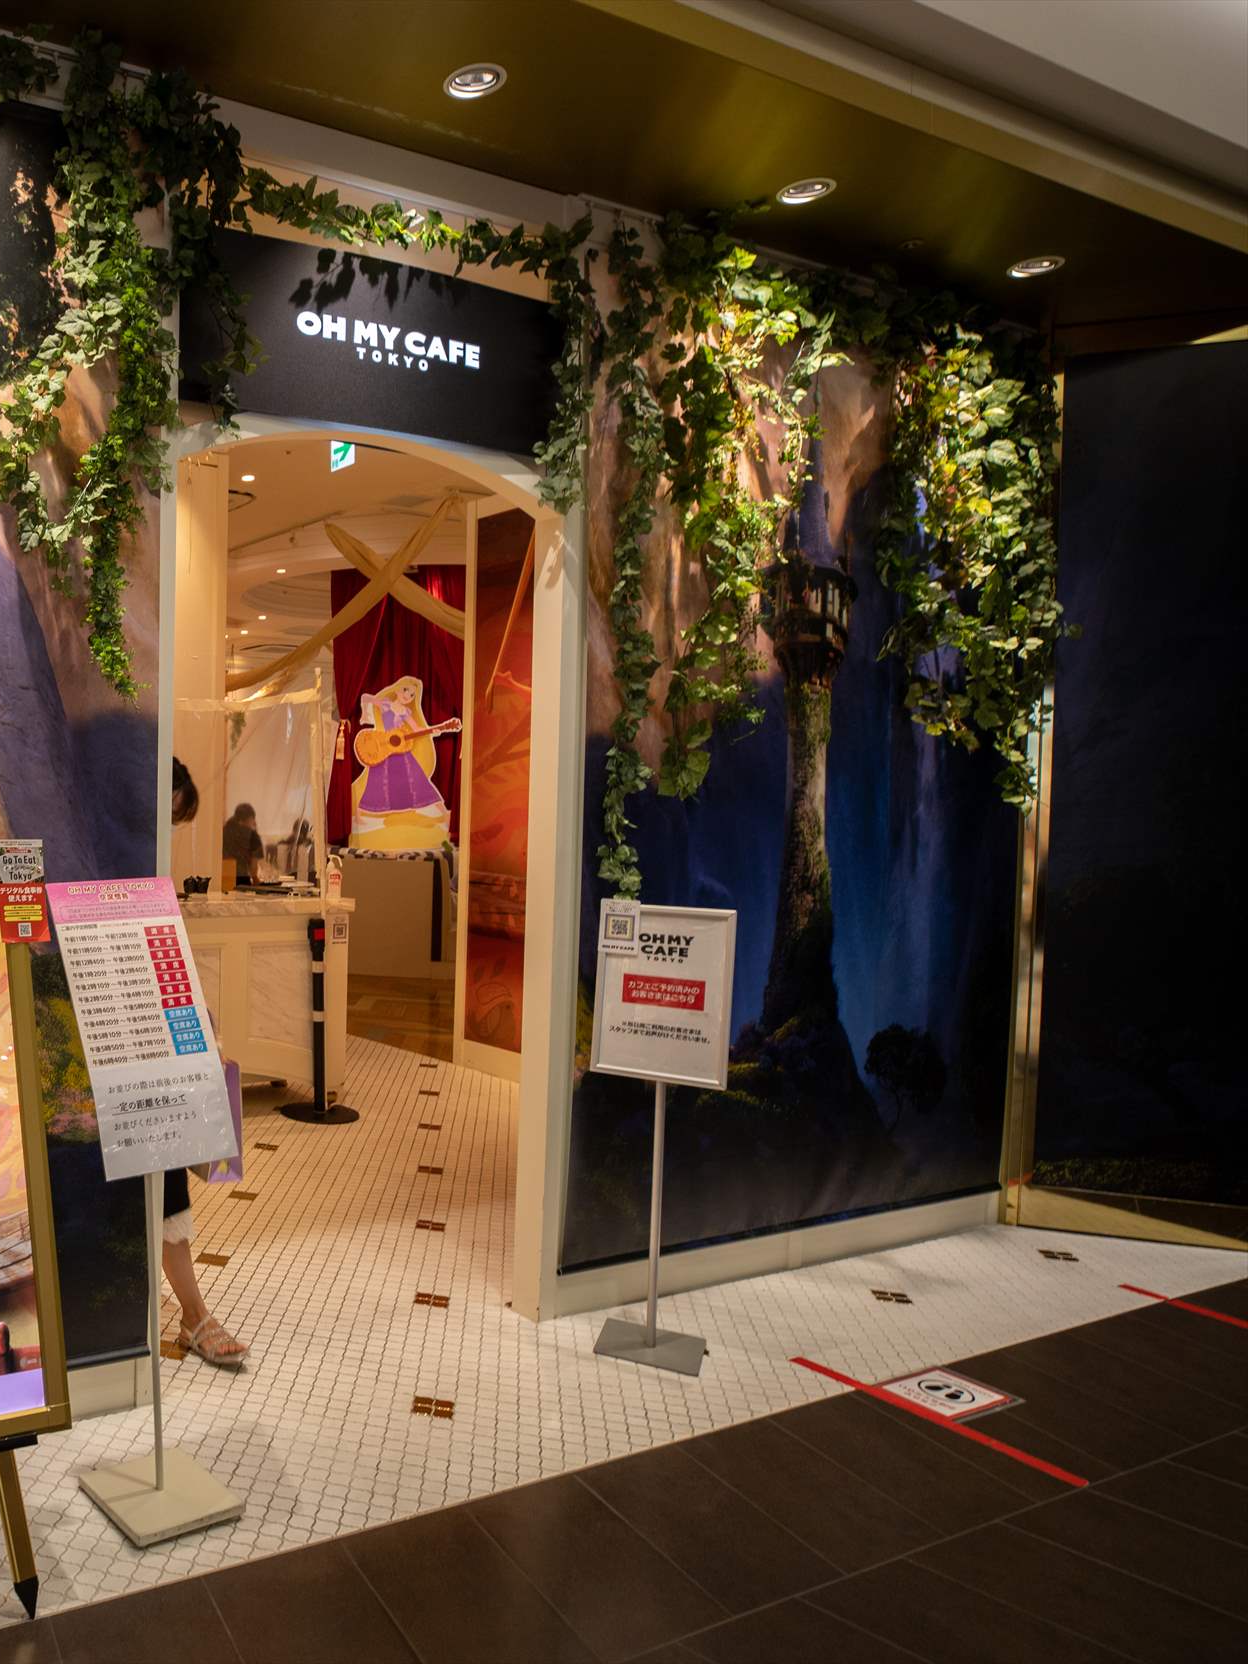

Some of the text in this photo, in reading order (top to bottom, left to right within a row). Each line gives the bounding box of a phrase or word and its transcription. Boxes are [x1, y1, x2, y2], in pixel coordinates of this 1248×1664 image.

[297, 311, 480, 370] OH MY CAFE
[357, 347, 429, 372] TOKYO
[2, 856, 36, 865] Go To Eat
[9, 871, 32, 882] Tokyo
[639, 933, 695, 946] OH MY
[641, 944, 689, 958] CAFE
[647, 956, 684, 964] TOKYO
[112, 1094, 186, 1112] 一定の距離を保って
[114, 1110, 197, 1131] お並びくださいますよう
[117, 1130, 182, 1148] お願いいたします。
